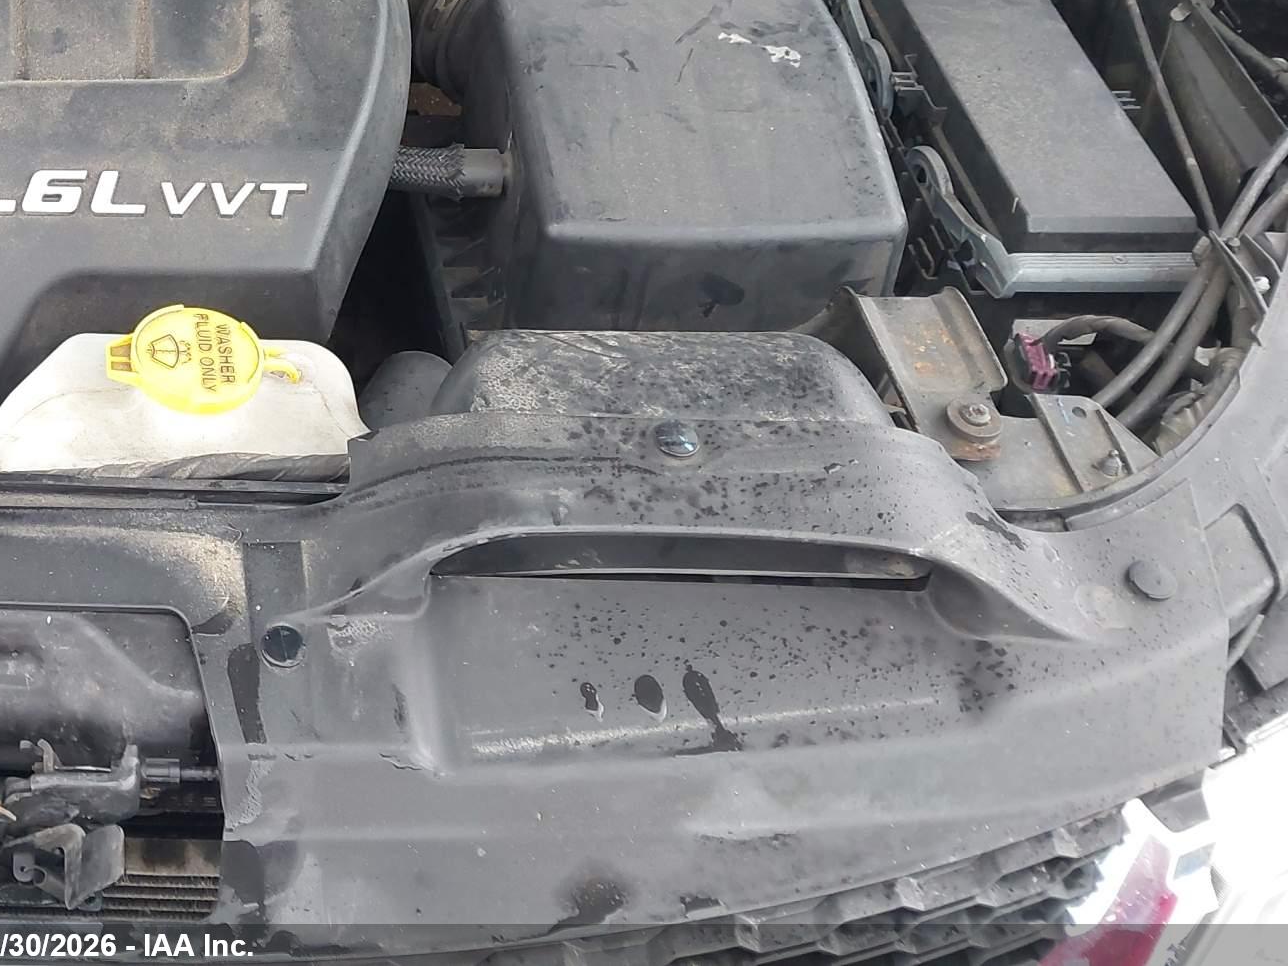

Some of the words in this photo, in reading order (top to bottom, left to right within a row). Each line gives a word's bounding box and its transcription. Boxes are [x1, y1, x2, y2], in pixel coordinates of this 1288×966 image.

[161, 182, 308, 218] VVT
[194, 313, 213, 353] FLUID
[215, 323, 236, 384] WASHER
[199, 356, 217, 393] ONLY
